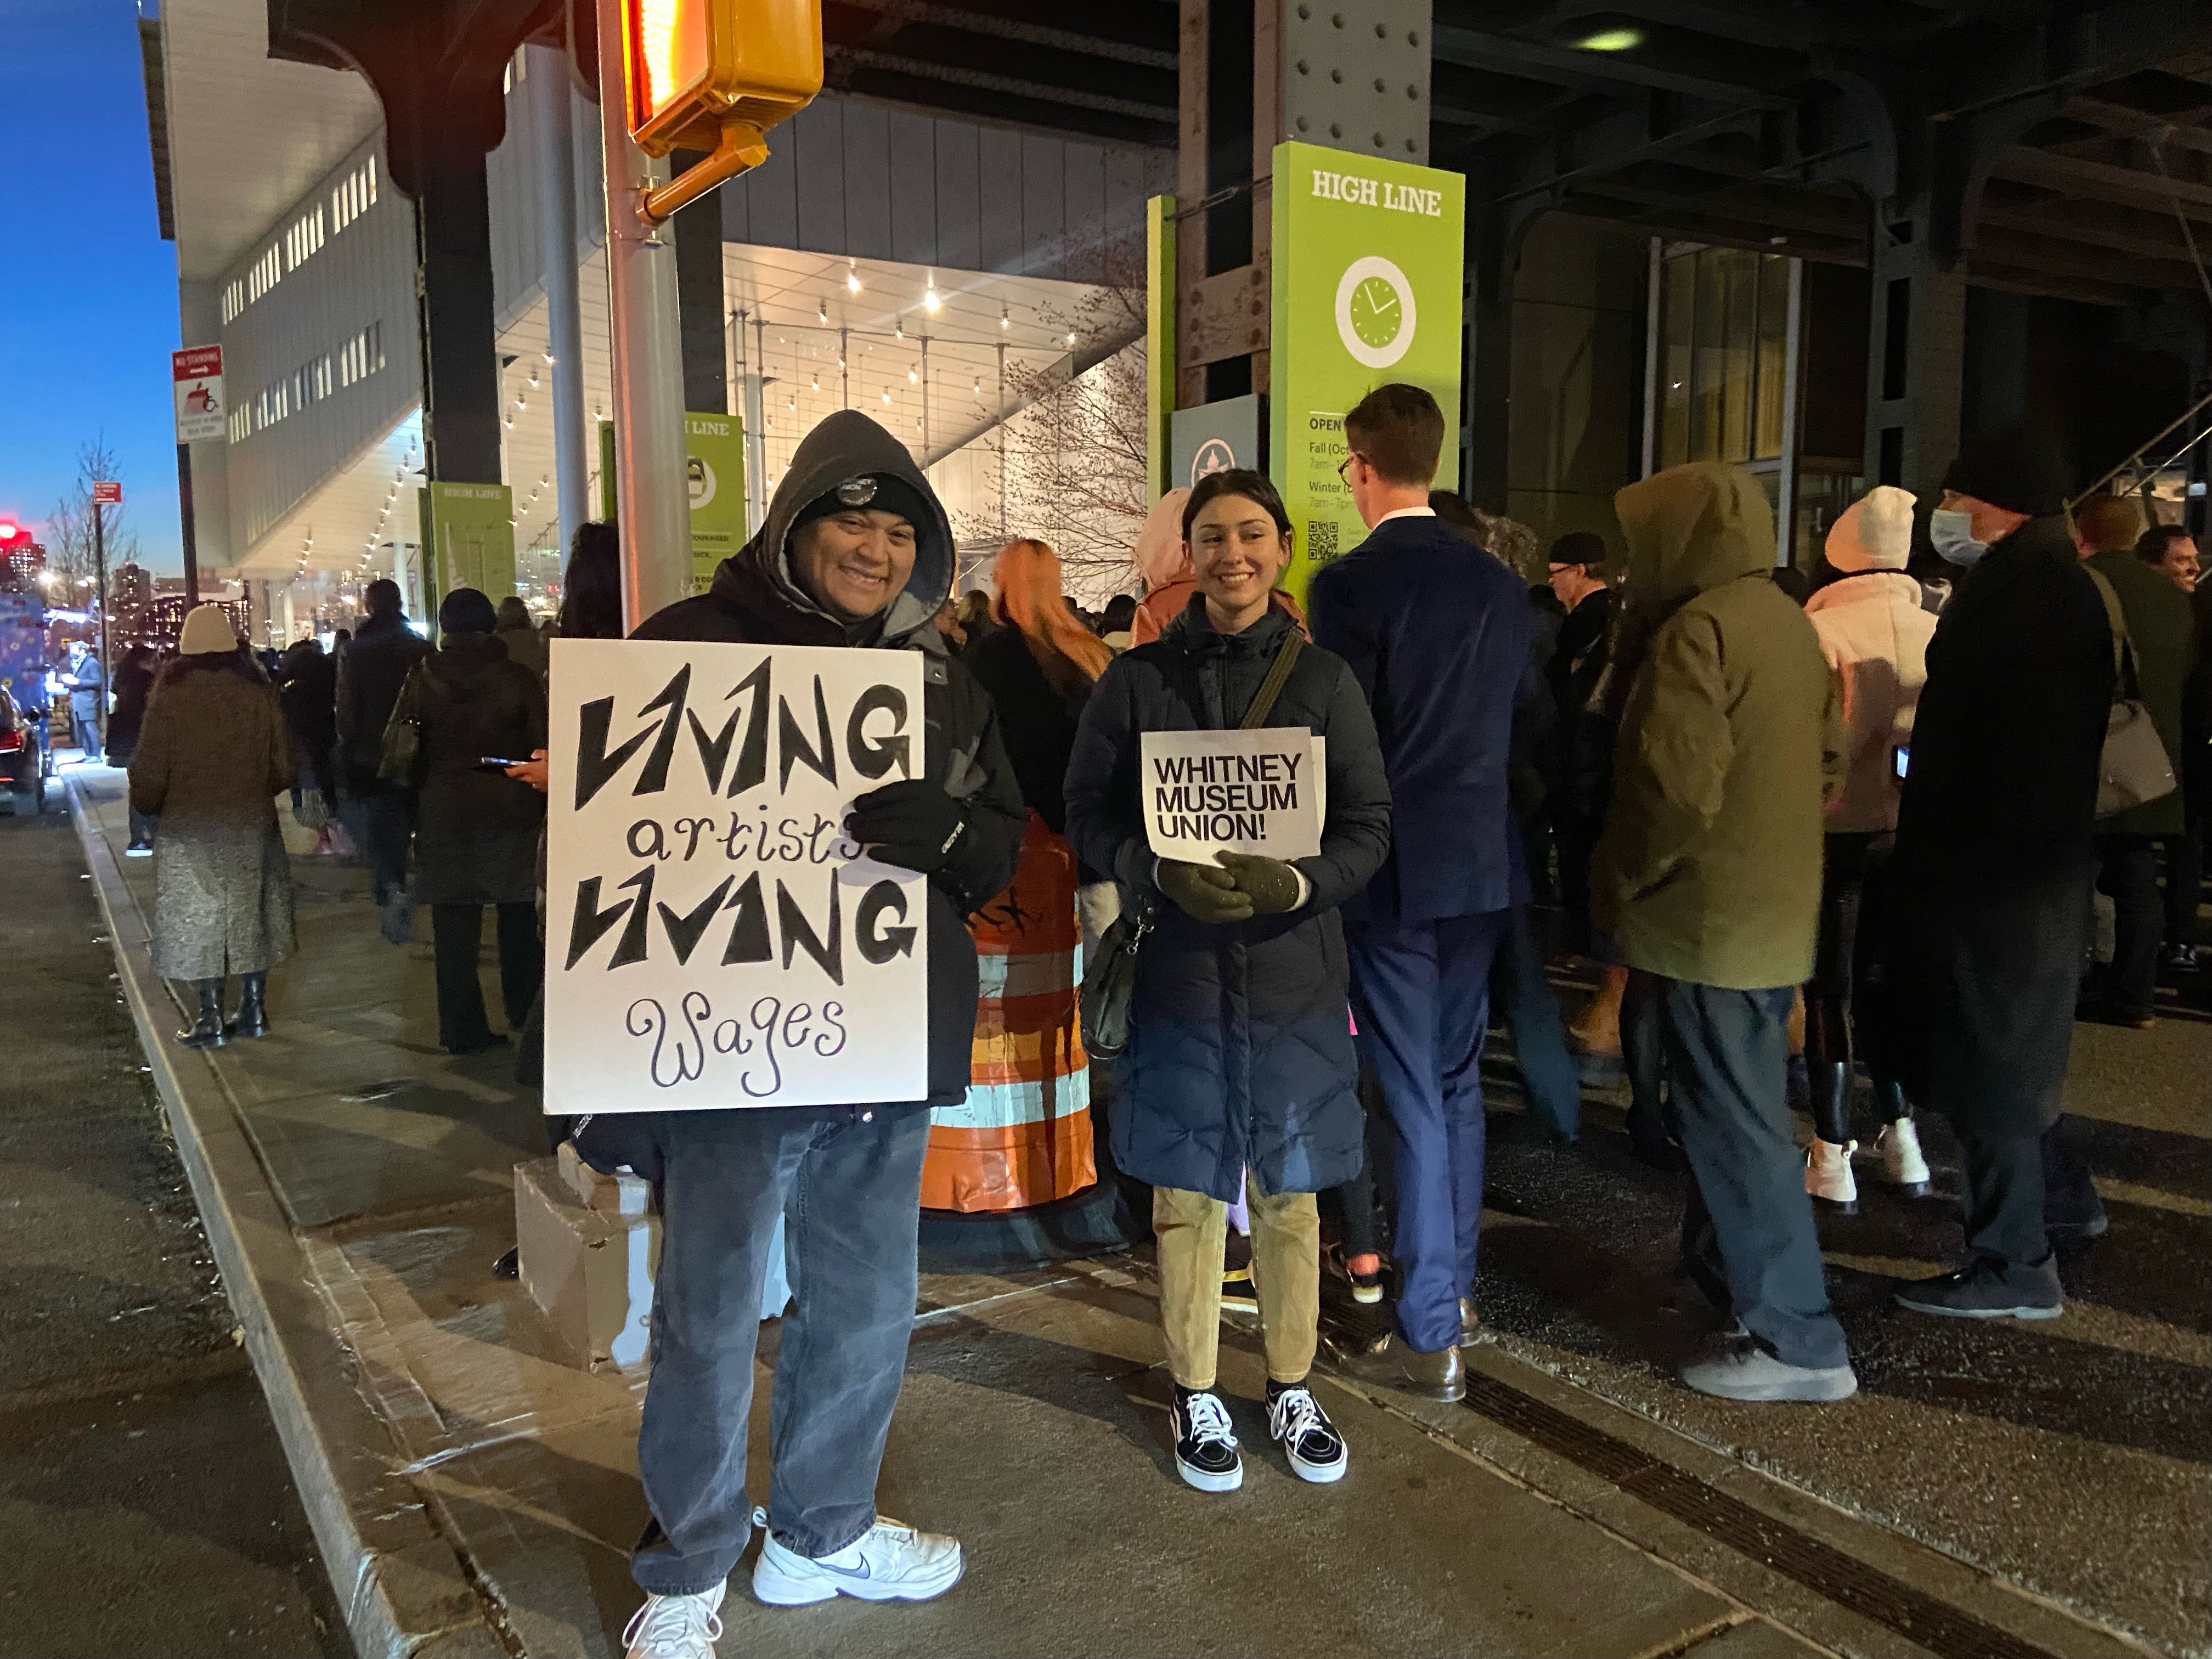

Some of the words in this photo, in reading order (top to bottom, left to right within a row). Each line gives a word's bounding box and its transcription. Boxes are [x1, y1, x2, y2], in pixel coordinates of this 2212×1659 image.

[1312, 170, 1378, 206] HIGH
[1383, 182, 1442, 217] LINE
[692, 421, 729, 436] LINE
[1310, 417, 1341, 432] OPEN
[1309, 442, 1326, 454] Fall
[1309, 481, 1341, 493] Winter
[575, 655, 911, 811] LIVING
[1153, 753, 1302, 785] WHITNEY
[1155, 782, 1298, 813] MUSEUM
[1156, 814, 1267, 841] UNION!
[564, 864, 917, 986] LIVING
[625, 991, 848, 1097] Wages
